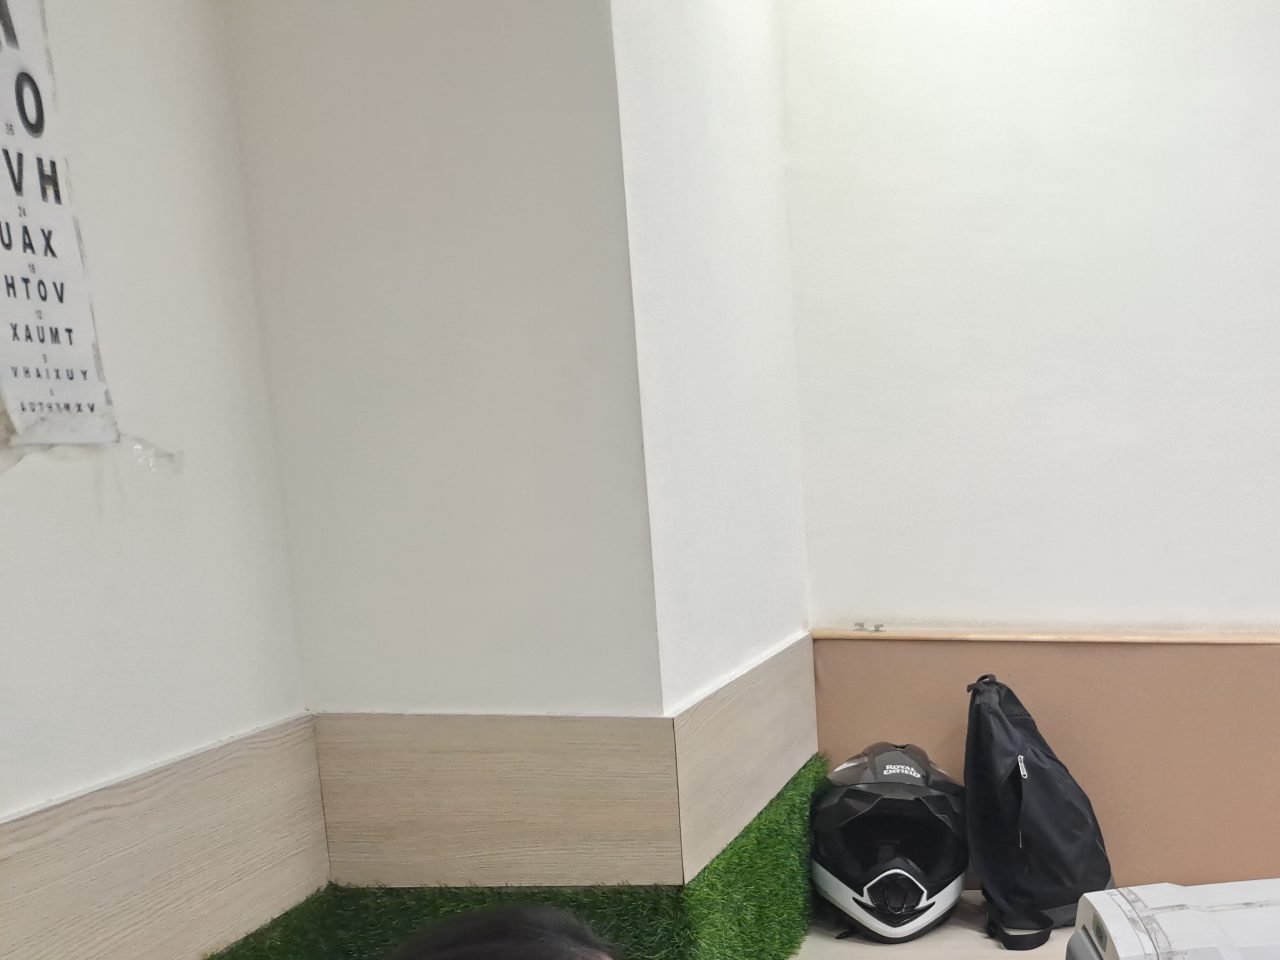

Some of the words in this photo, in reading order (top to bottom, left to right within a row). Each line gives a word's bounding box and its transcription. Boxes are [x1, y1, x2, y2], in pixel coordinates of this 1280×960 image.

[15, 71, 45, 138] O
[4, 274, 64, 304] HTOV
[10, 322, 73, 346] XAUMT
